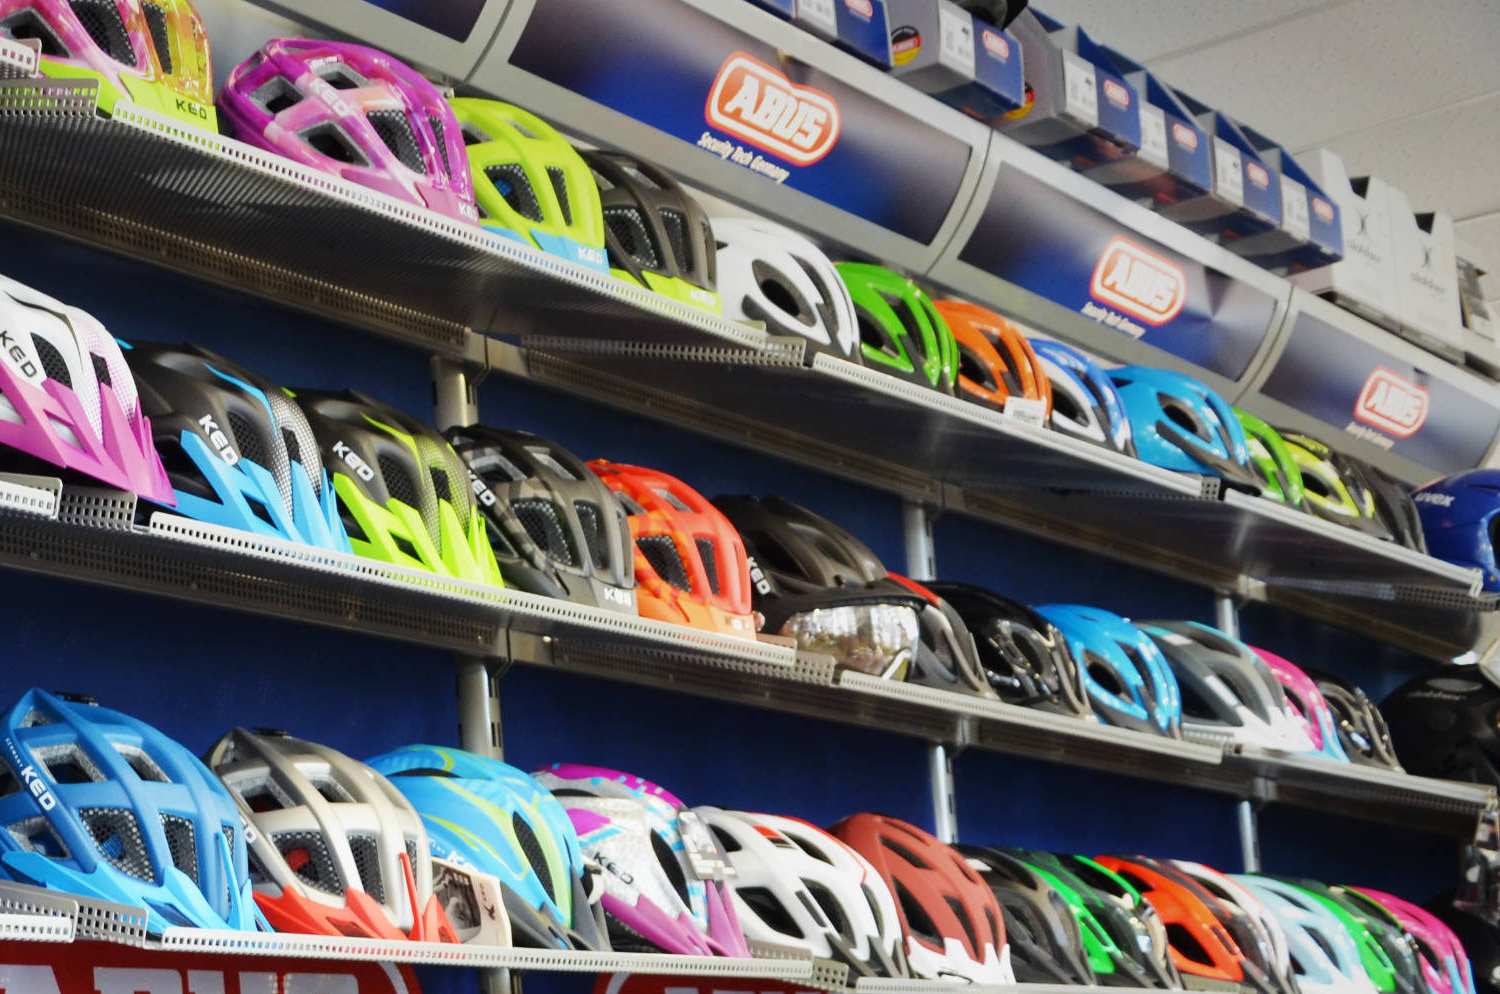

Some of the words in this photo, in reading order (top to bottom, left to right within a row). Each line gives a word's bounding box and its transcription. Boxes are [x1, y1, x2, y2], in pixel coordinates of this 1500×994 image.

[176, 97, 207, 120] KED
[309, 78, 350, 117] KED
[723, 73, 827, 149] ABUS
[198, 413, 240, 467] KED
[332, 439, 375, 482] KED
[20, 765, 57, 812] KED
[594, 851, 634, 885] KED
